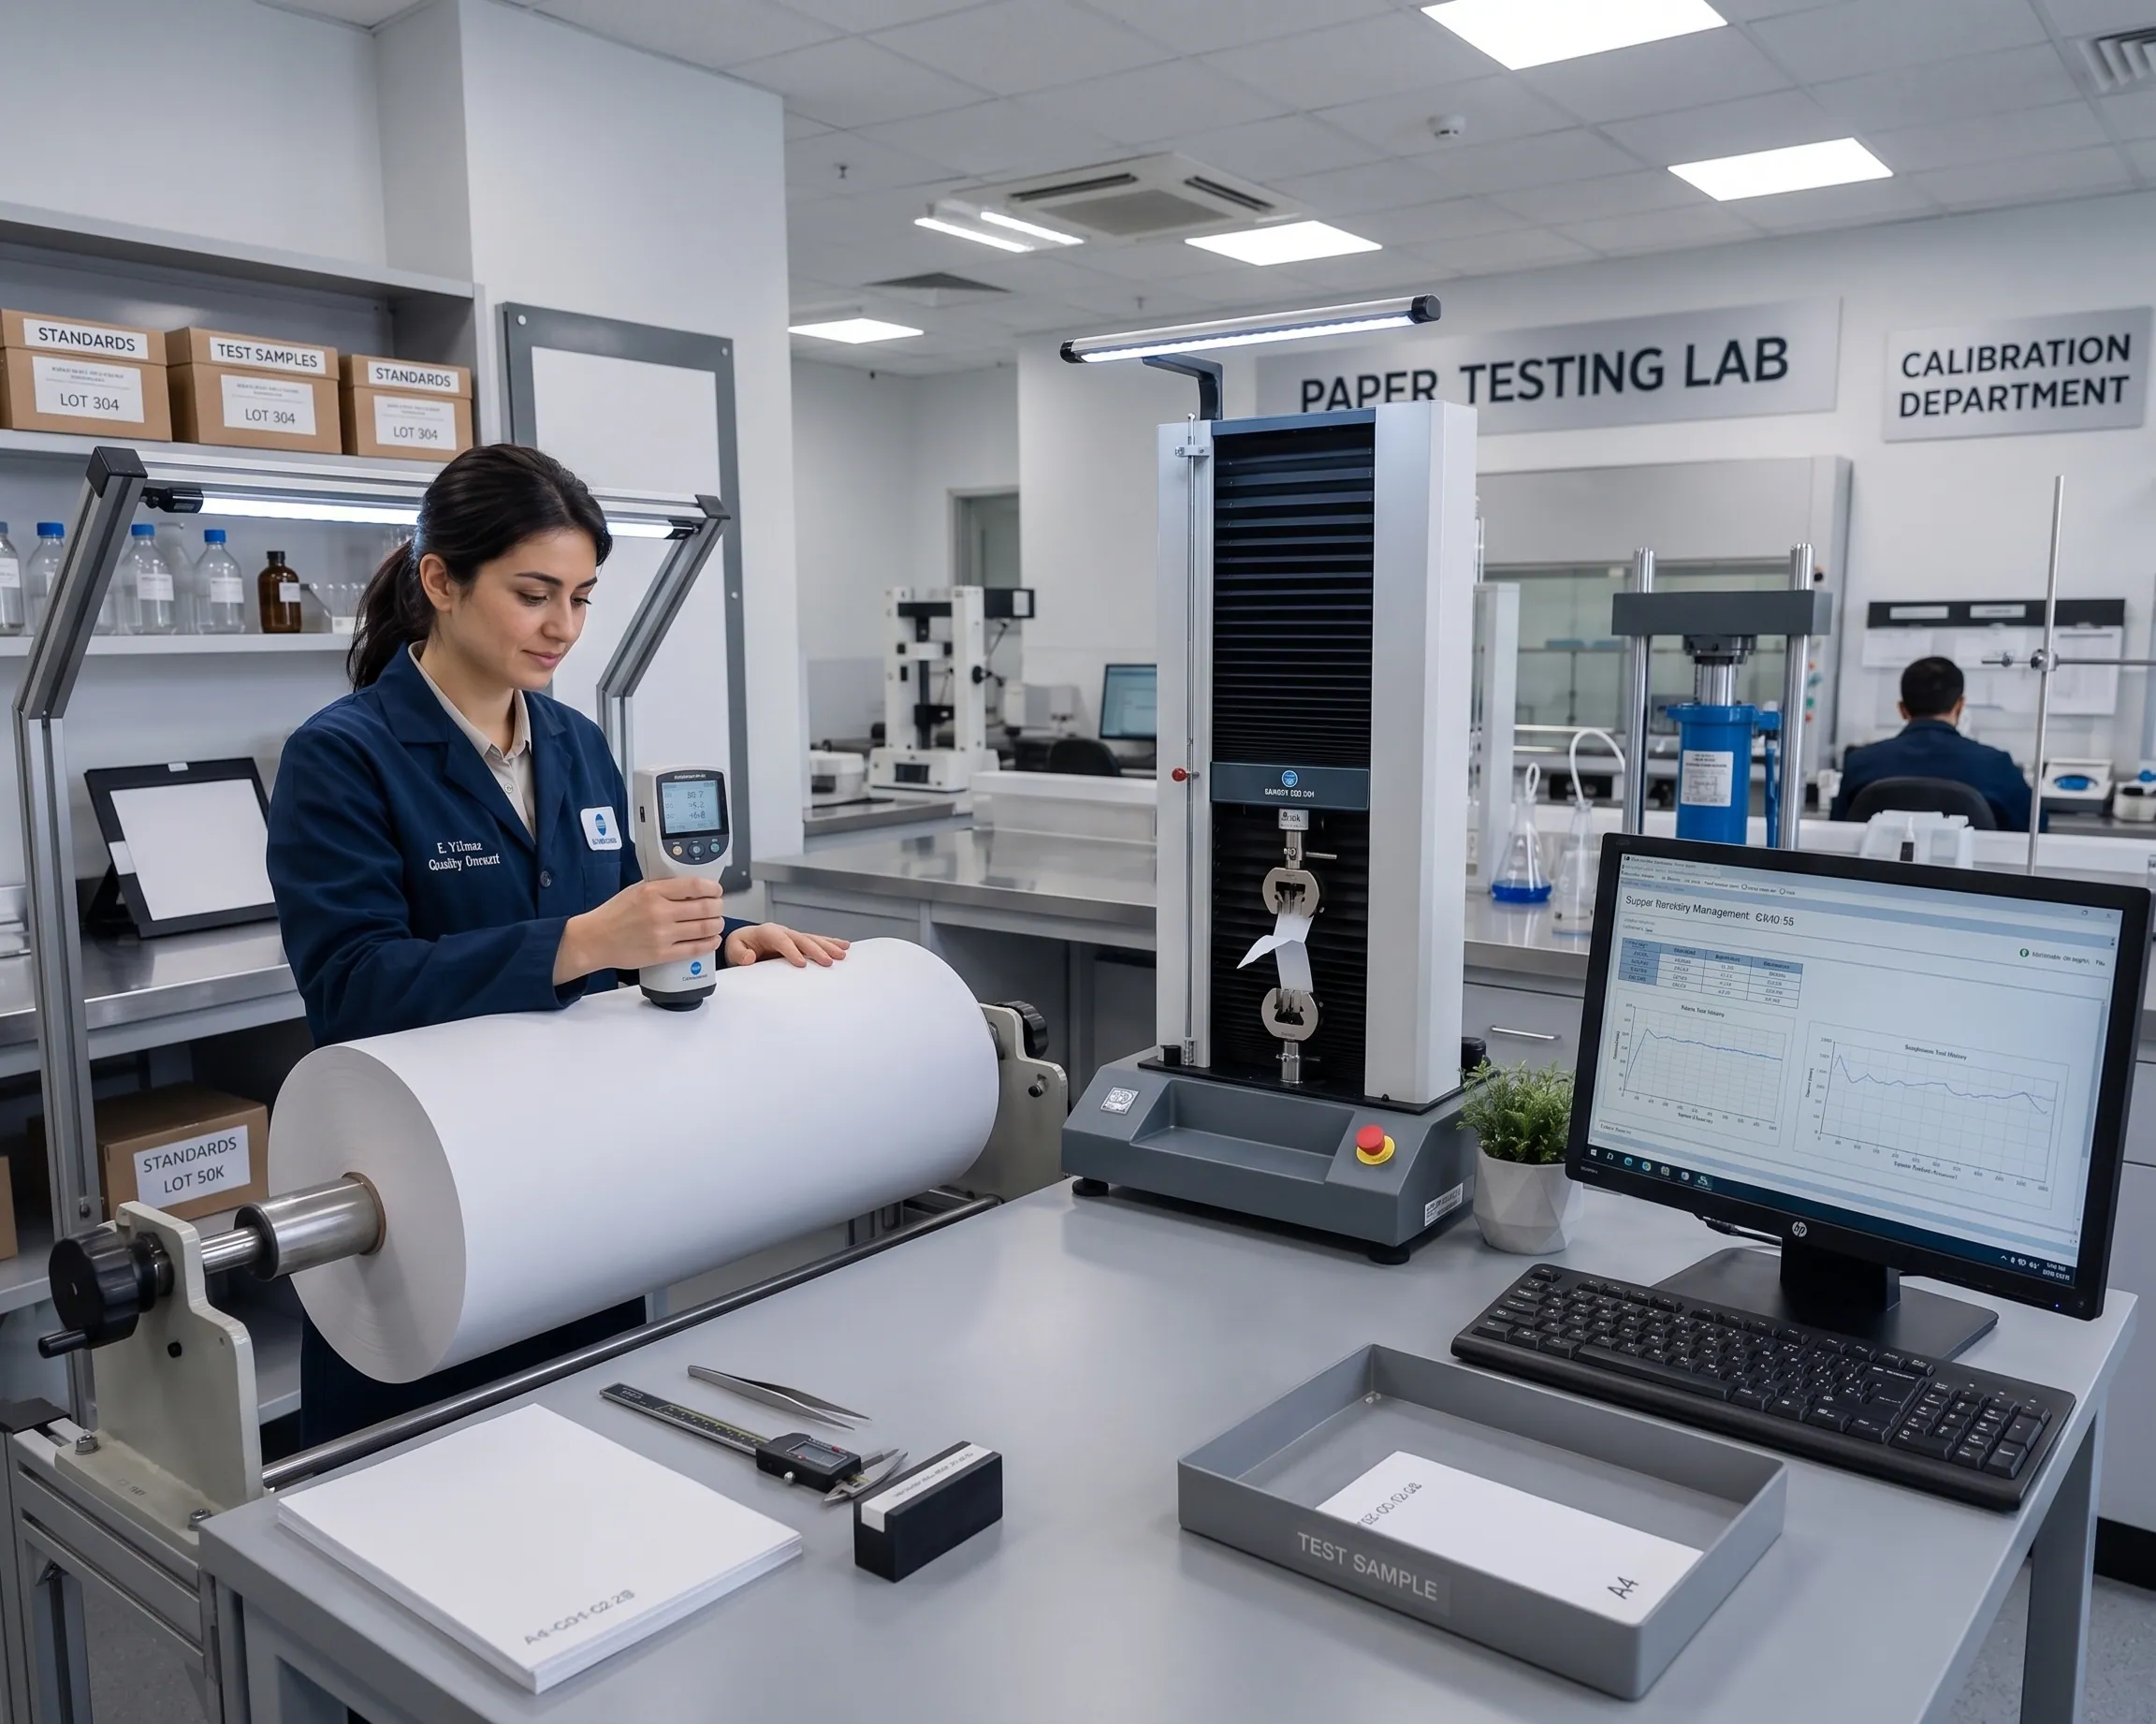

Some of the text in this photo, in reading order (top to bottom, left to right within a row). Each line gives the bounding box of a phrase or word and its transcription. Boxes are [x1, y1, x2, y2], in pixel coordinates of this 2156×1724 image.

[38, 327, 136, 352] STANDARDS
[217, 343, 318, 368] TEST SAMPLES
[1901, 332, 2132, 379] CALIBRATION
[375, 367, 451, 387] STANDARDS
[1301, 336, 1790, 413] PAPER TESTING LAB
[60, 392, 120, 411] LOT 304
[1899, 374, 2131, 418] DEPARTMENT
[245, 408, 296, 425] LOT 304
[393, 426, 438, 440] LOT 304
[437, 842, 447, 854] E.
[143, 1136, 238, 1174] STANDARDS
[164, 1164, 226, 1194] LOT 50K
[1792, 1221, 1807, 1237] hp
[1297, 1531, 1438, 1602] TEST SAMPLE
[1607, 1576, 1639, 1600] A4
